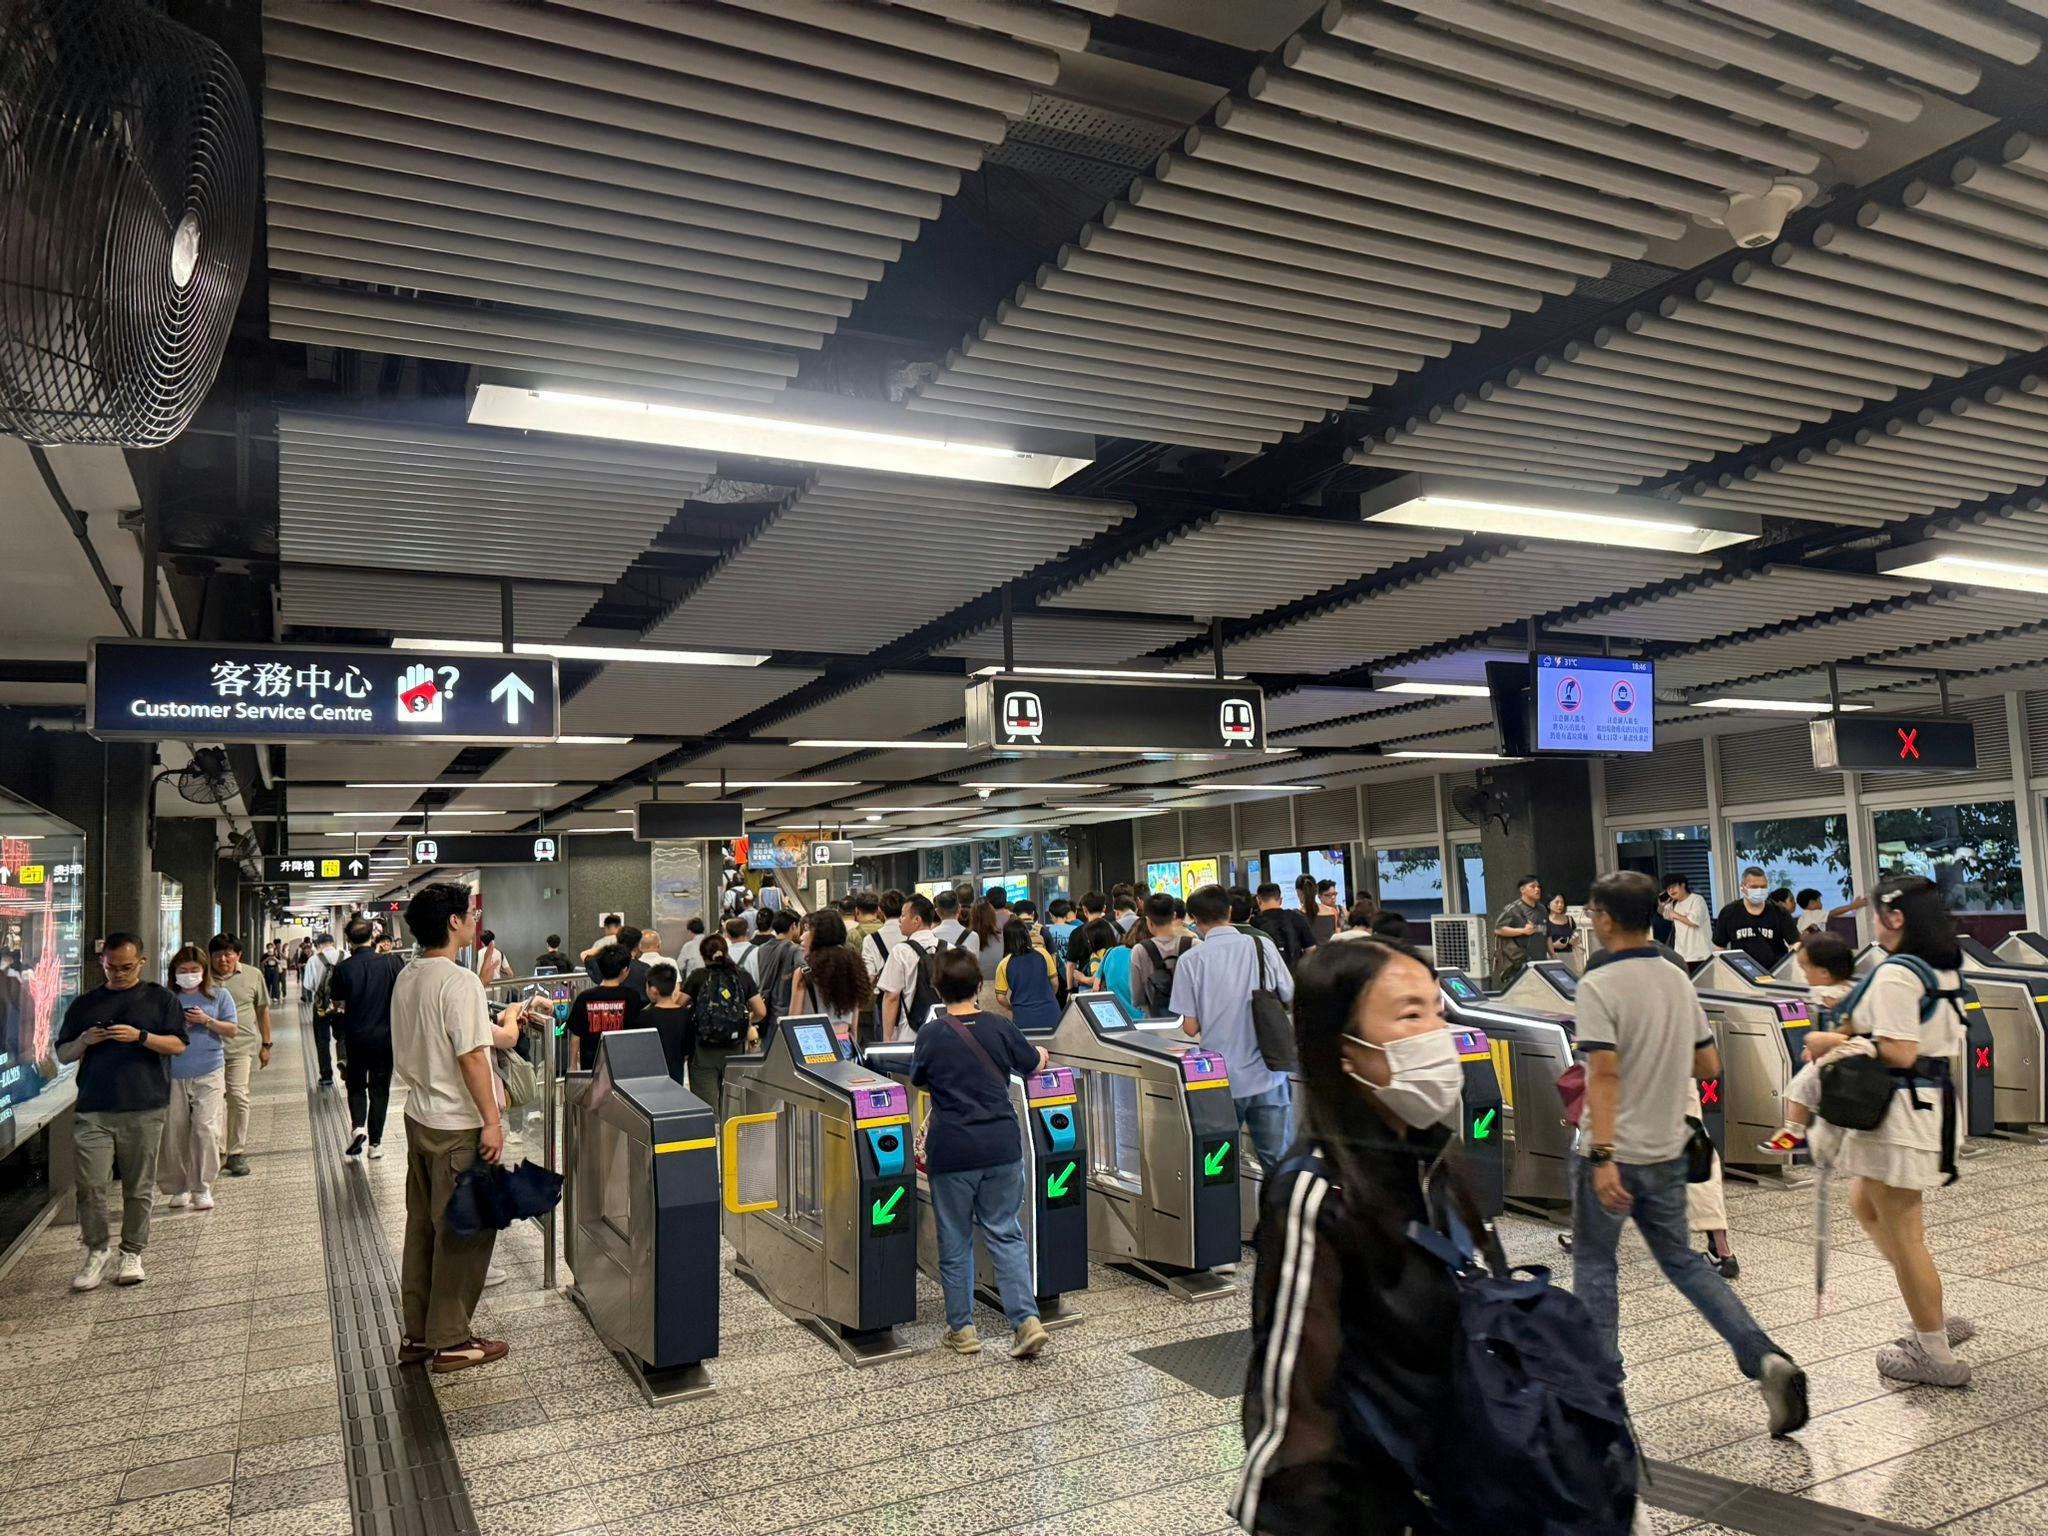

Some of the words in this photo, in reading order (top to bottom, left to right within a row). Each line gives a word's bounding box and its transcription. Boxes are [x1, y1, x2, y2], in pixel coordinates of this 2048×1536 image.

[1632, 662, 1647, 671] 18:46
[210, 661, 373, 698] 客務中心
[131, 699, 232, 719] Customer
[235, 703, 306, 720] Service
[310, 704, 373, 722] Centre
[279, 860, 315, 872] 升降機
[1736, 927, 1774, 939] SURUS
